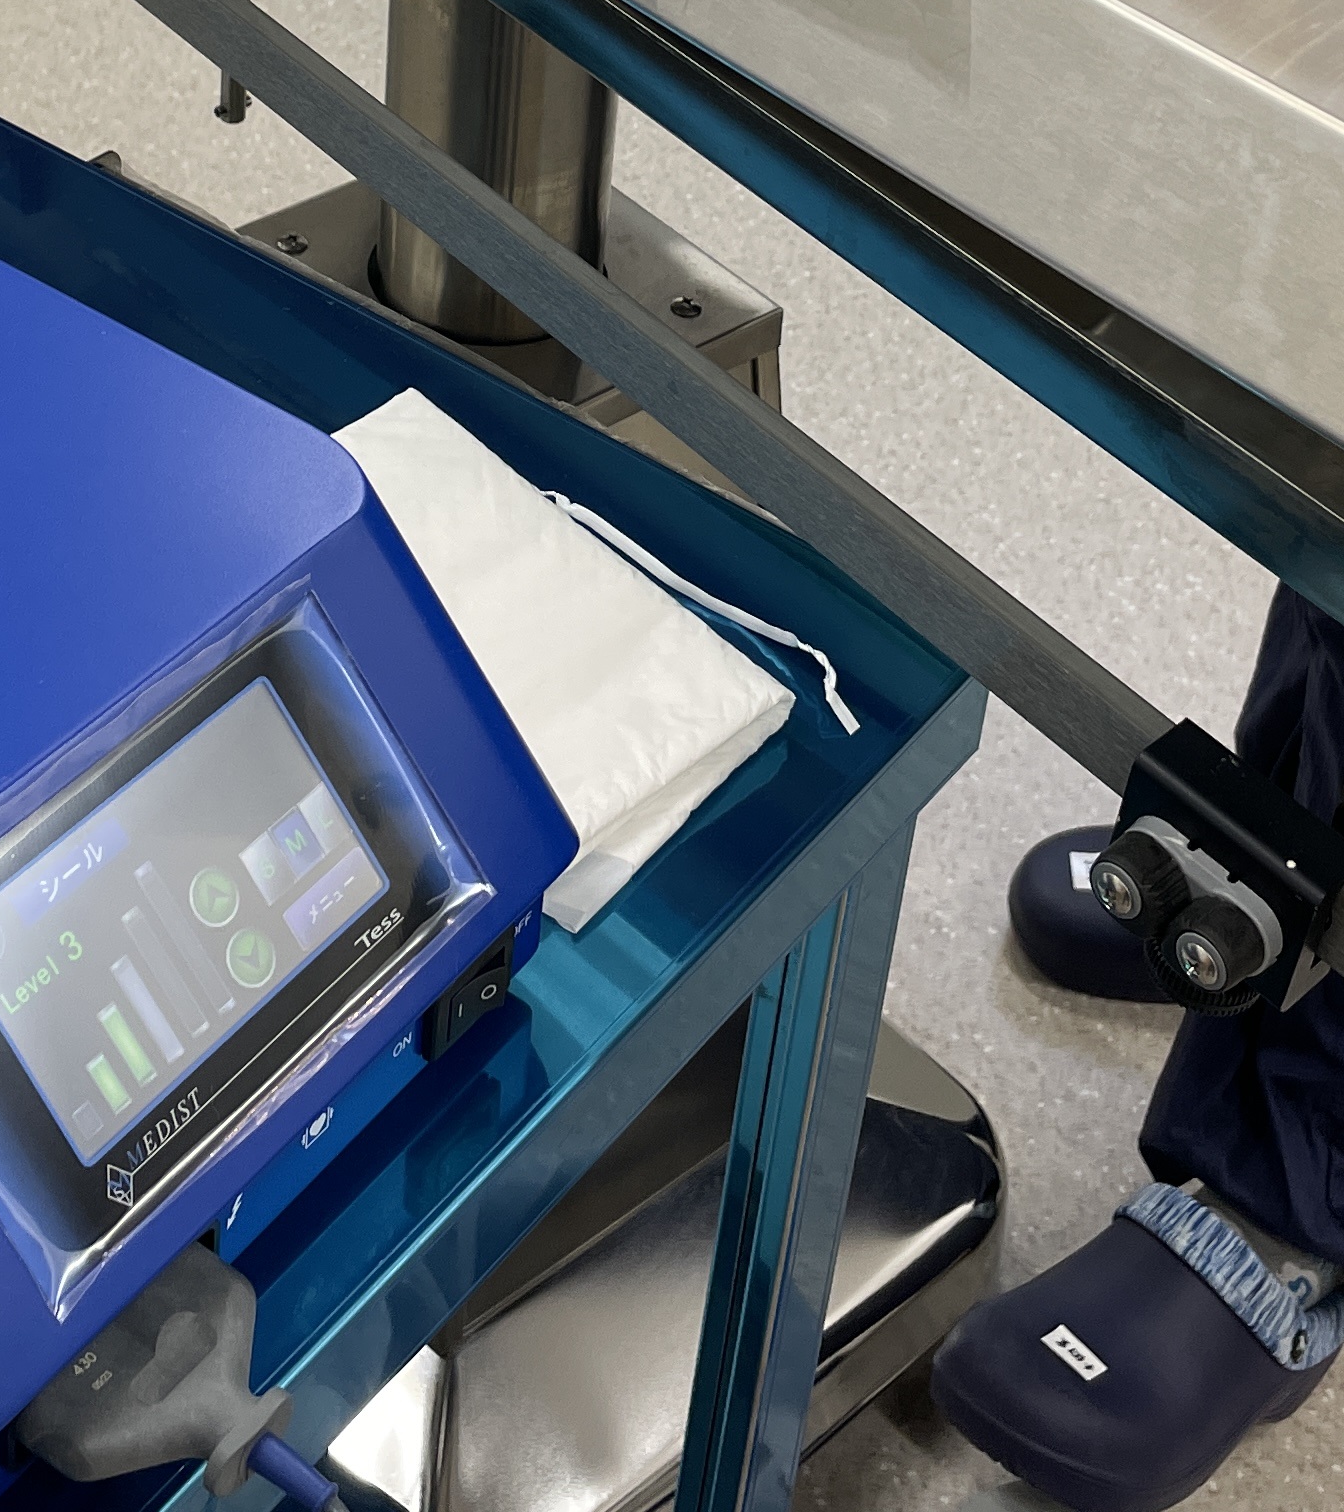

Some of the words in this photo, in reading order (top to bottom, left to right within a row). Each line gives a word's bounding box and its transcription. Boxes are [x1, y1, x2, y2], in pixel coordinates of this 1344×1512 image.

[284, 828, 308, 856] M
[39, 842, 103, 903] シール
[308, 875, 356, 925] メニュー
[353, 907, 402, 949] Tess
[0, 954, 60, 1015] Level
[59, 930, 83, 962] 3
[392, 1031, 413, 1058] ON
[126, 1086, 201, 1170] MEDIST
